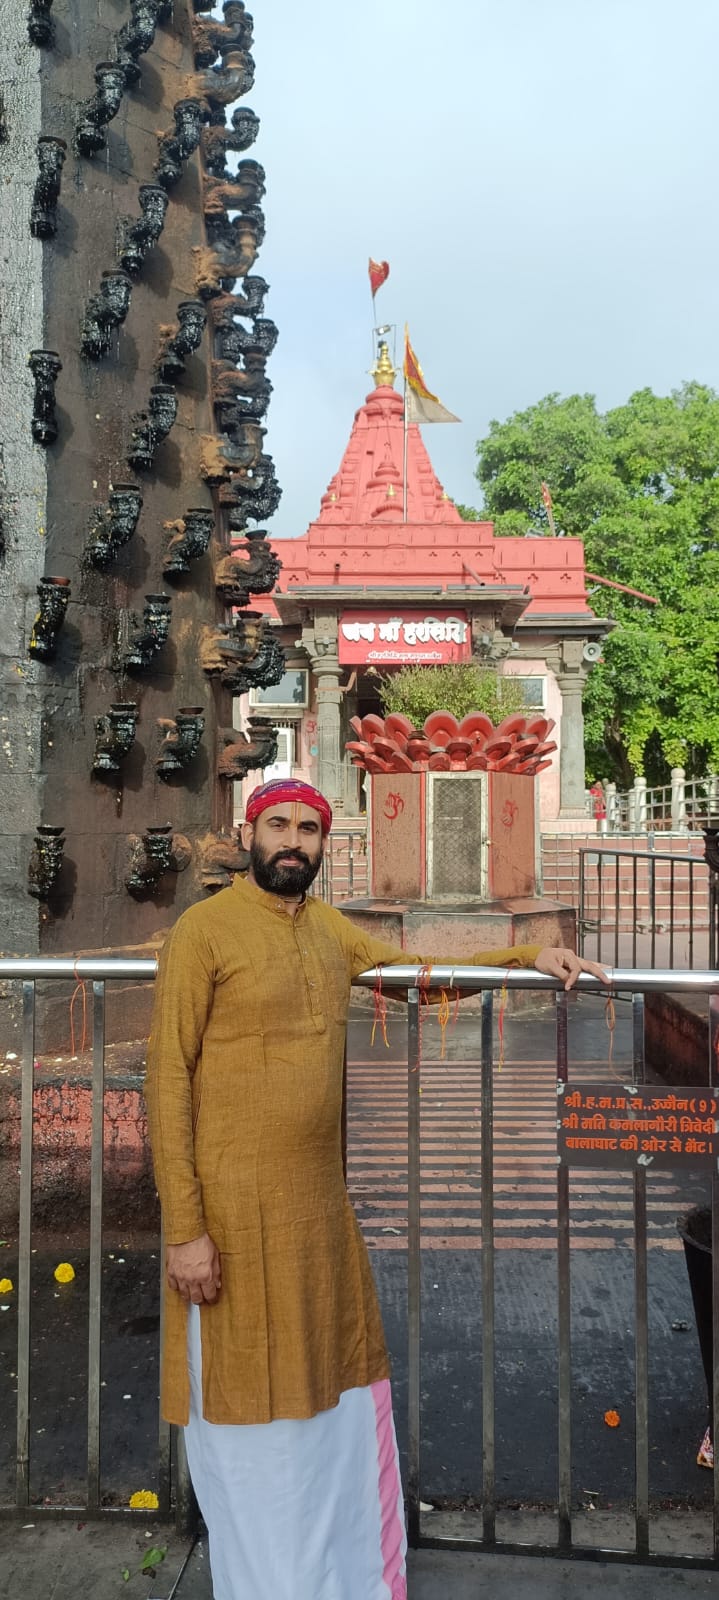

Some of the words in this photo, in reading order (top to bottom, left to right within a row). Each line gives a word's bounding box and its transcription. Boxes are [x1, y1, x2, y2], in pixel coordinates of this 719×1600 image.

[341, 622, 376, 642] जय
[561, 1113, 579, 1129] श्री
[581, 1113, 607, 1130] मति
[608, 1115, 678, 1133] कमलागौरी
[565, 1136, 618, 1150] बालाघाट
[619, 1135, 639, 1151] की
[641, 1136, 667, 1152] ओर
[669, 1136, 682, 1152] से
